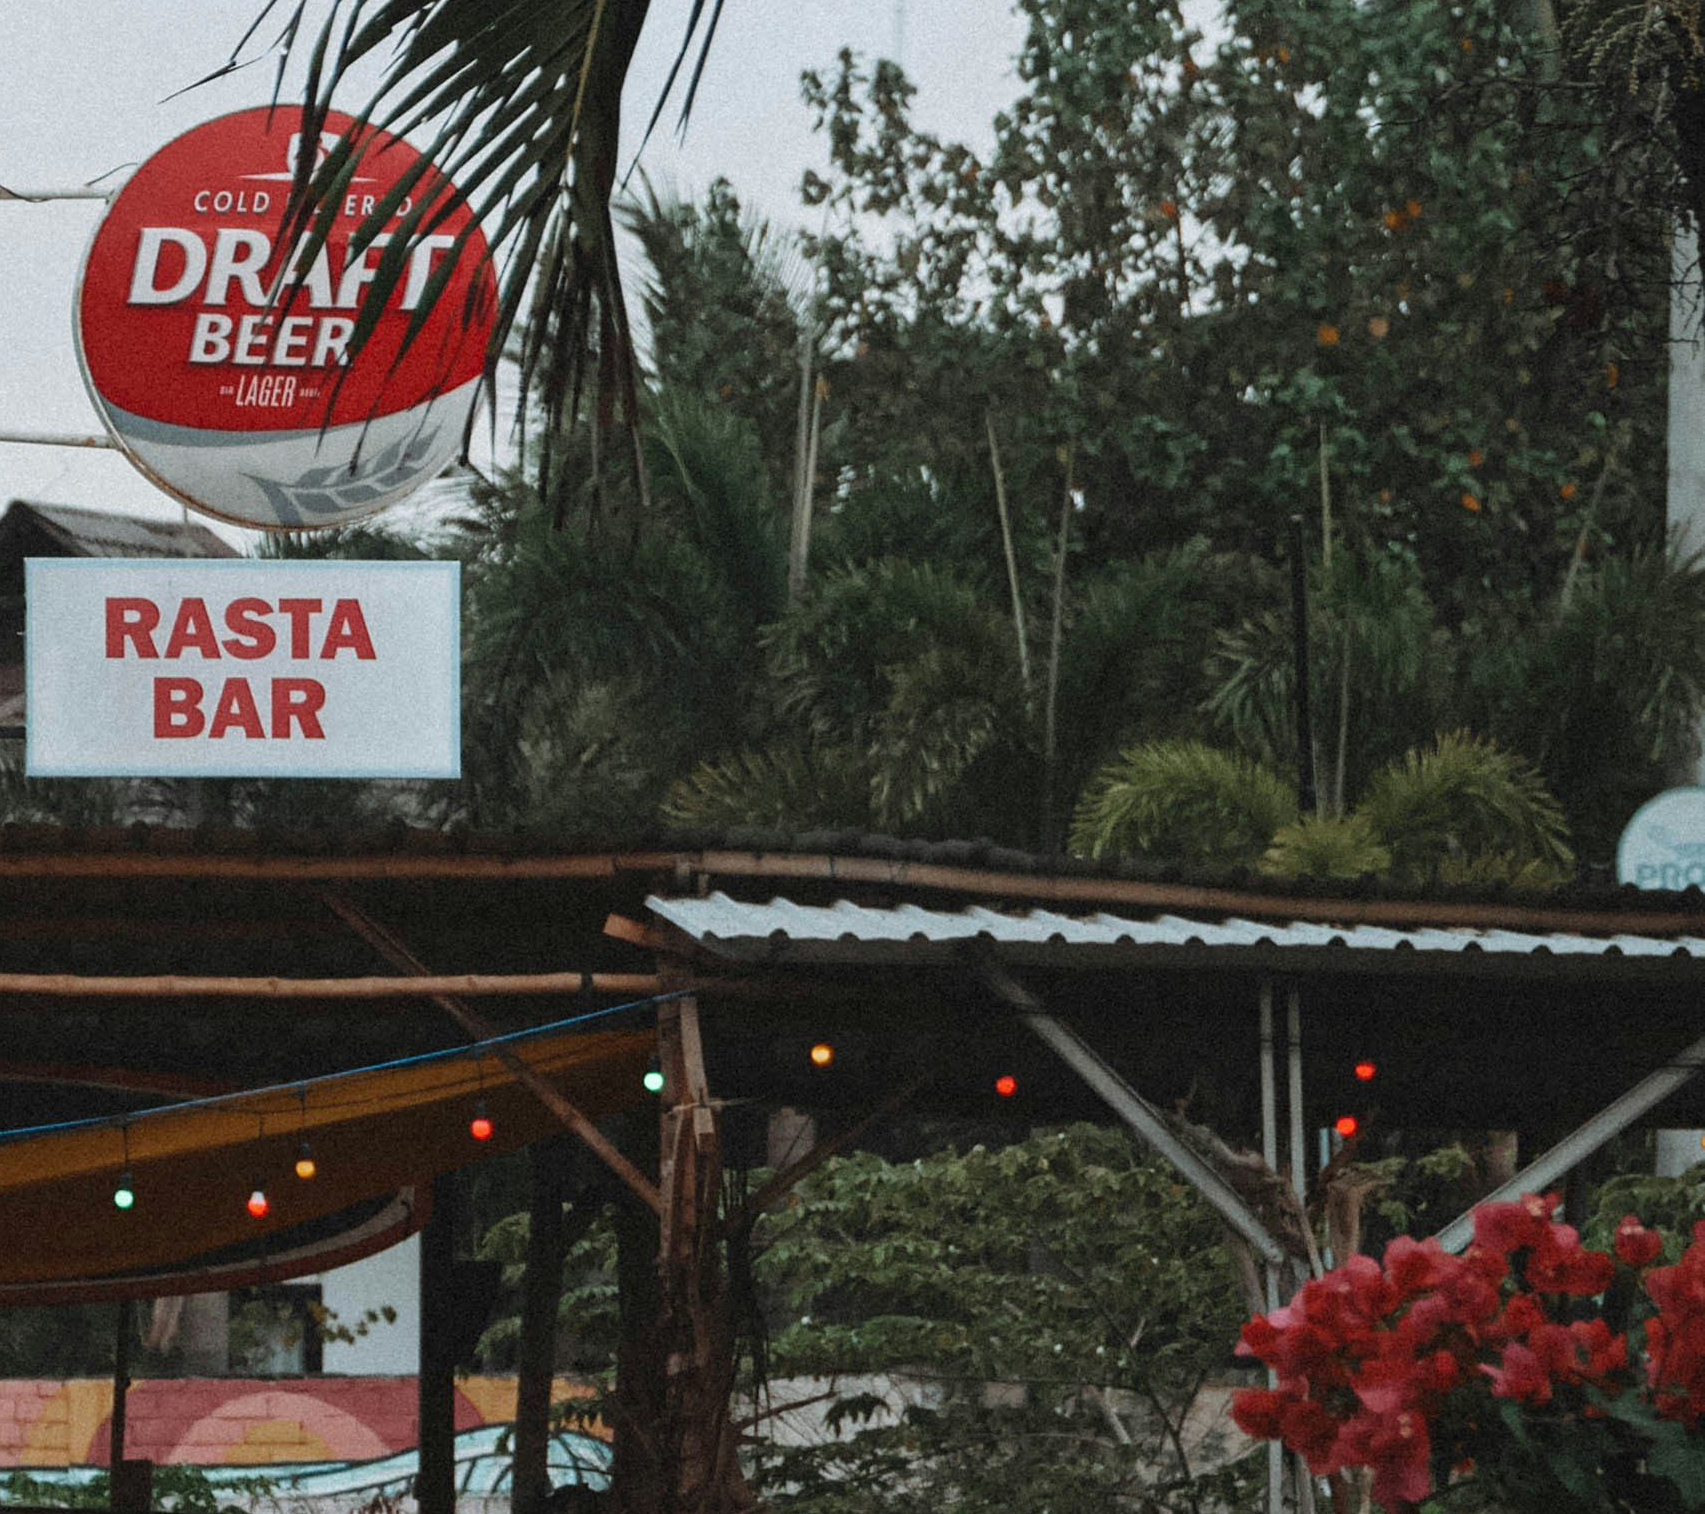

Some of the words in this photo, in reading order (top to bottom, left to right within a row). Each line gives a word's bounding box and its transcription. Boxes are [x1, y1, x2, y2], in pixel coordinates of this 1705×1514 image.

[194, 190, 270, 213] COLD
[128, 227, 455, 310] DRAFT
[189, 313, 357, 367] BEER
[235, 374, 297, 407] LAGER
[105, 597, 377, 660] RASTA
[153, 677, 326, 739] BAR
